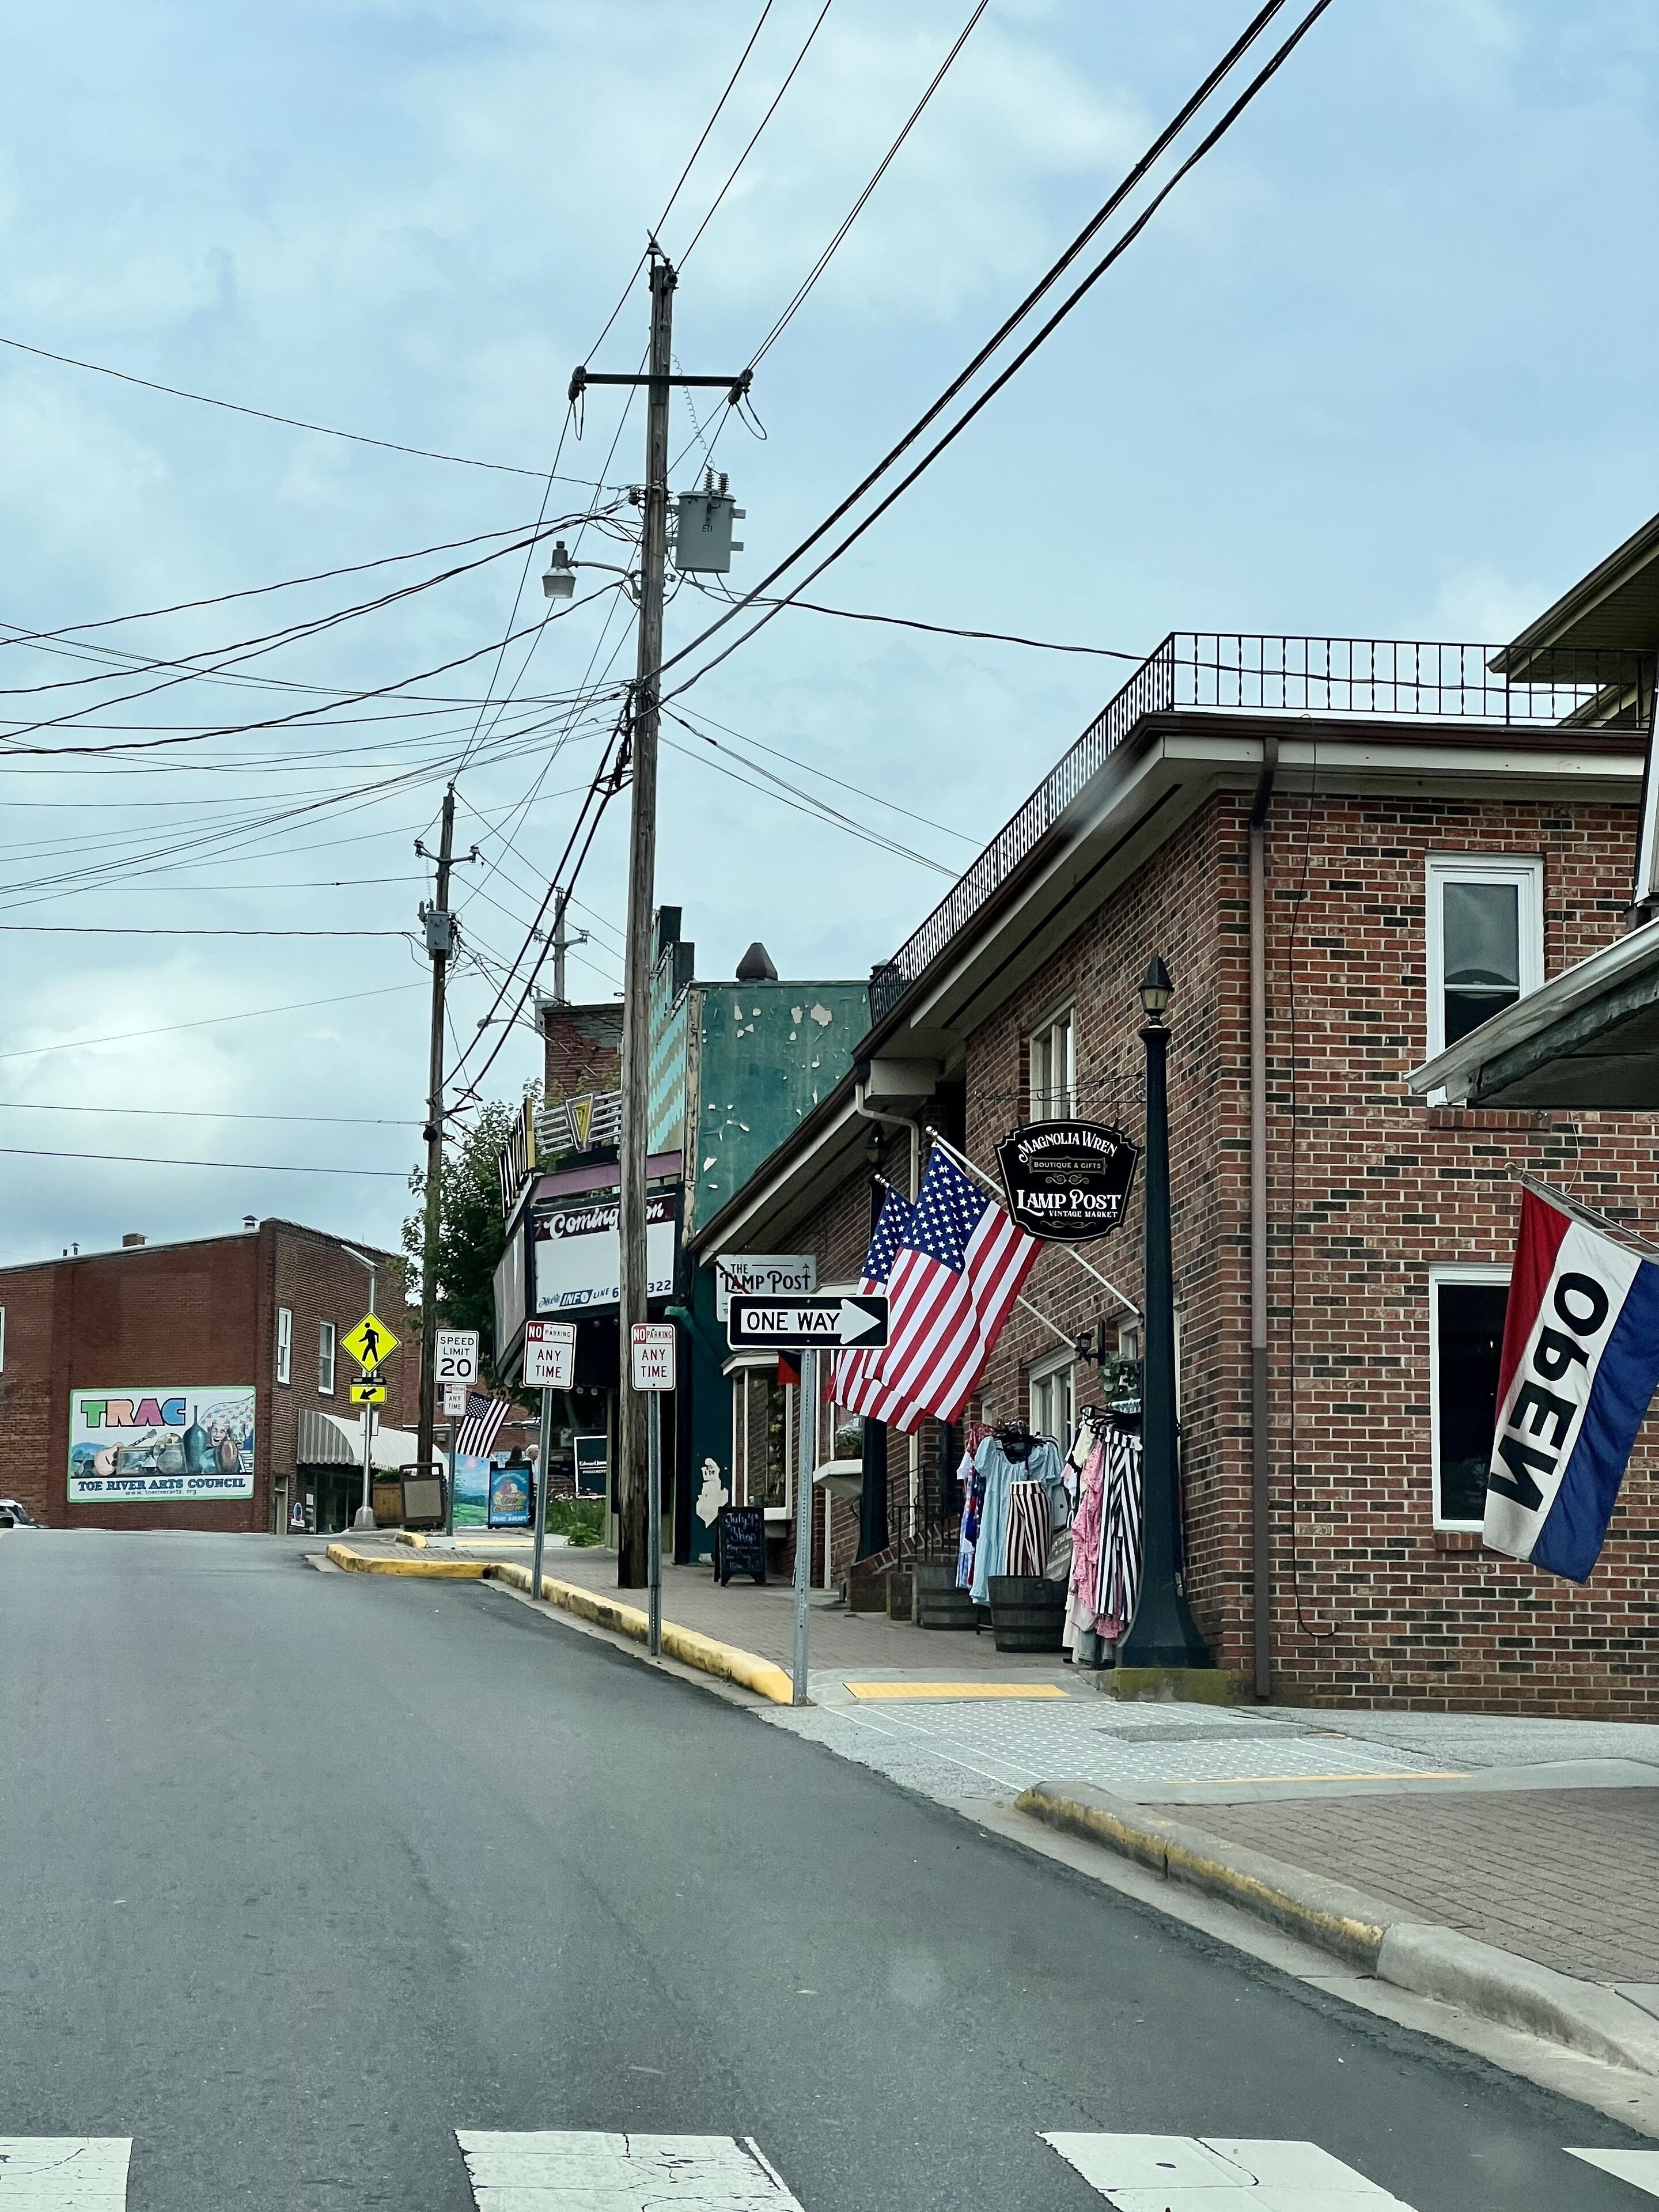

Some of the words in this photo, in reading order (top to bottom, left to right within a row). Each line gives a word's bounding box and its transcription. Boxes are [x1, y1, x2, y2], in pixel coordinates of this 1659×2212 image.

[1017, 1132, 1080, 1163] MAGNOLIA
[1082, 1131, 1118, 1157] WREN
[1017, 1190, 1066, 1217] LAMP
[1069, 1189, 1122, 1210] POST
[544, 1207, 619, 1239] Coming
[730, 1264, 748, 1274] THE
[767, 1270, 811, 1293] POST
[562, 1291, 589, 1305] INFO
[593, 1287, 609, 1299] LINE
[747, 1312, 788, 1331] ONE
[797, 1312, 840, 1331] WAY
[529, 1326, 542, 1338] NO
[545, 1330, 571, 1338] PARKING
[634, 1328, 646, 1341] NO
[646, 1331, 672, 1339] PARKING
[440, 1336, 474, 1346] SPEED
[443, 1347, 470, 1356] LIMIT
[537, 1349, 561, 1361] ANY
[642, 1349, 665, 1361] ANY
[440, 1358, 472, 1377] 20
[535, 1365, 562, 1378] TIME
[641, 1366, 667, 1377] TIME
[81, 1397, 187, 1427] TRAC
[78, 1481, 102, 1491] TOE
[106, 1480, 146, 1491] RIVER
[148, 1479, 184, 1490] ARTS
[187, 1478, 246, 1488] COUNCIL
[725, 1513, 747, 1529] July
[730, 1527, 756, 1544] Shop
